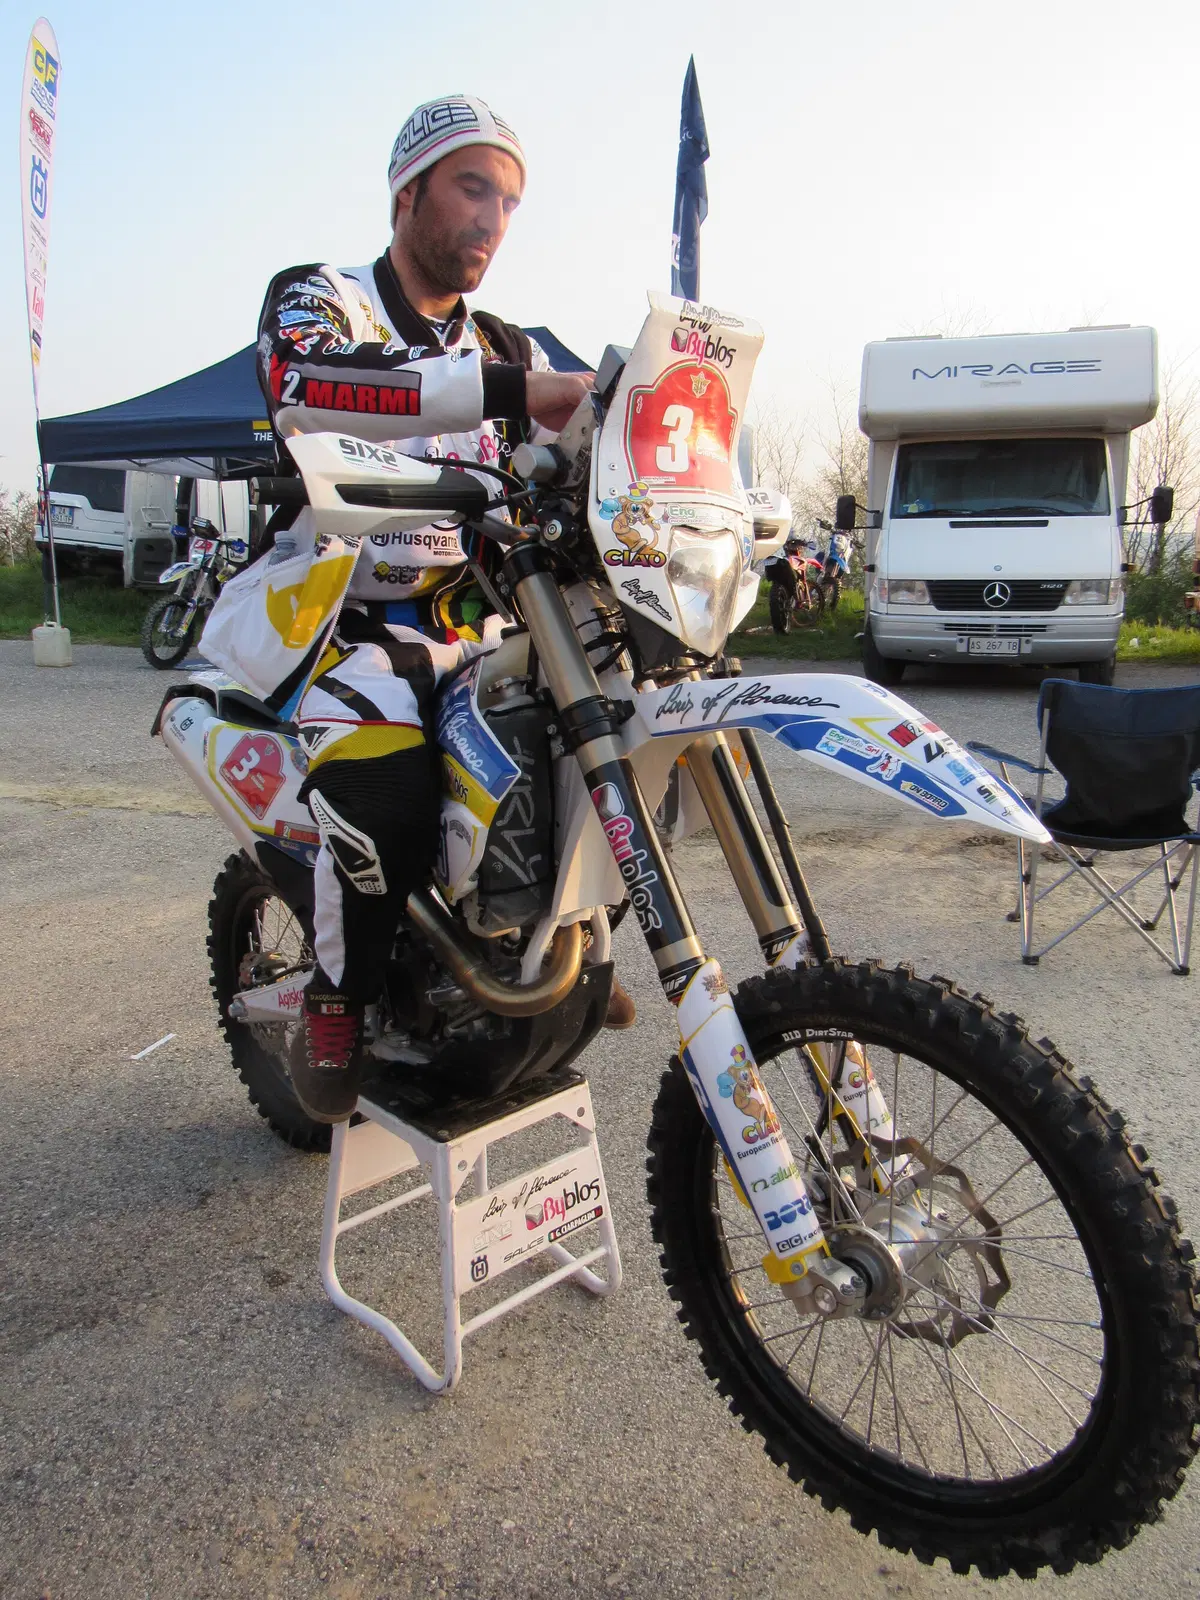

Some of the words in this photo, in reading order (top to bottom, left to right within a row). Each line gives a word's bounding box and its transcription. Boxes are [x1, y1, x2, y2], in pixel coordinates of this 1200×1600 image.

[686, 332, 737, 368] Byblos
[912, 359, 1102, 380] MIRAGE
[281, 371, 301, 405] 2
[305, 379, 420, 416] MARMI
[253, 432, 273, 441] THE
[655, 404, 694, 473] 3
[339, 438, 398, 467] SIX2
[603, 549, 667, 569] CIAO
[969, 641, 981, 650] AS
[986, 641, 1003, 651] 267
[1007, 641, 1018, 651] TB
[231, 747, 261, 781] 3
[603, 814, 663, 934] Byblos
[737, 1141, 771, 1160] European
[543, 1178, 600, 1221] Byblos
[503, 1235, 544, 1263] SALICE
